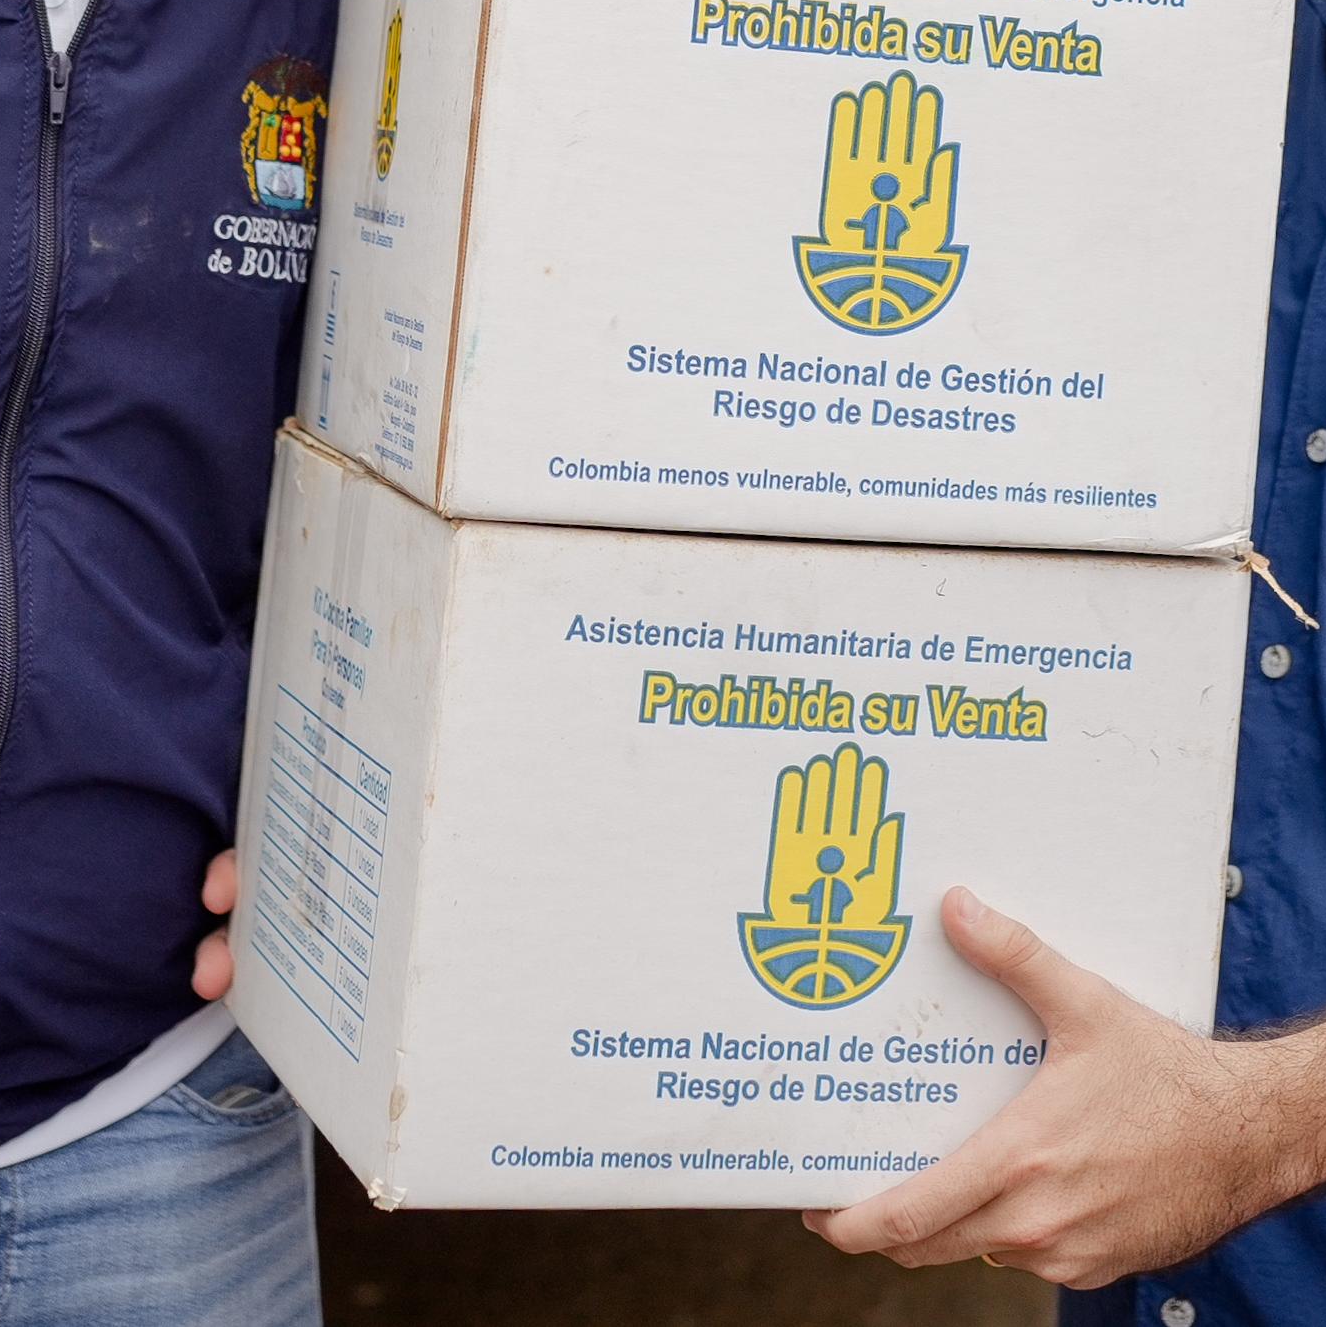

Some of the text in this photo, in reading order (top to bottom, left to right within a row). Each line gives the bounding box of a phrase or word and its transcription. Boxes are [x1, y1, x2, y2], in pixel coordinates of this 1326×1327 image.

[912, 18, 973, 65] su
[979, 13, 1104, 77] Venta
[207, 247, 233, 275] de
[626, 344, 1105, 400] Sistema Nacional de Gestión del
[713, 389, 1018, 434] Riesgo de Desastres
[548, 455, 1158, 510] Colombia menos vulnerable, comunidades más resilientes
[564, 614, 1133, 674] Asistencia Humanitaria de Emergencia
[638, 668, 1049, 742] Prohibida su Venta
[359, 760, 389, 806] Cantidad
[570, 1028, 1047, 1067] Sistema Nacional de Gestión del
[656, 1071, 959, 1108] Riesgo de Desastres
[490, 1144, 594, 1168] Colombia
[601, 1149, 673, 1169] menos
[679, 1148, 796, 1173] vulnerable,
